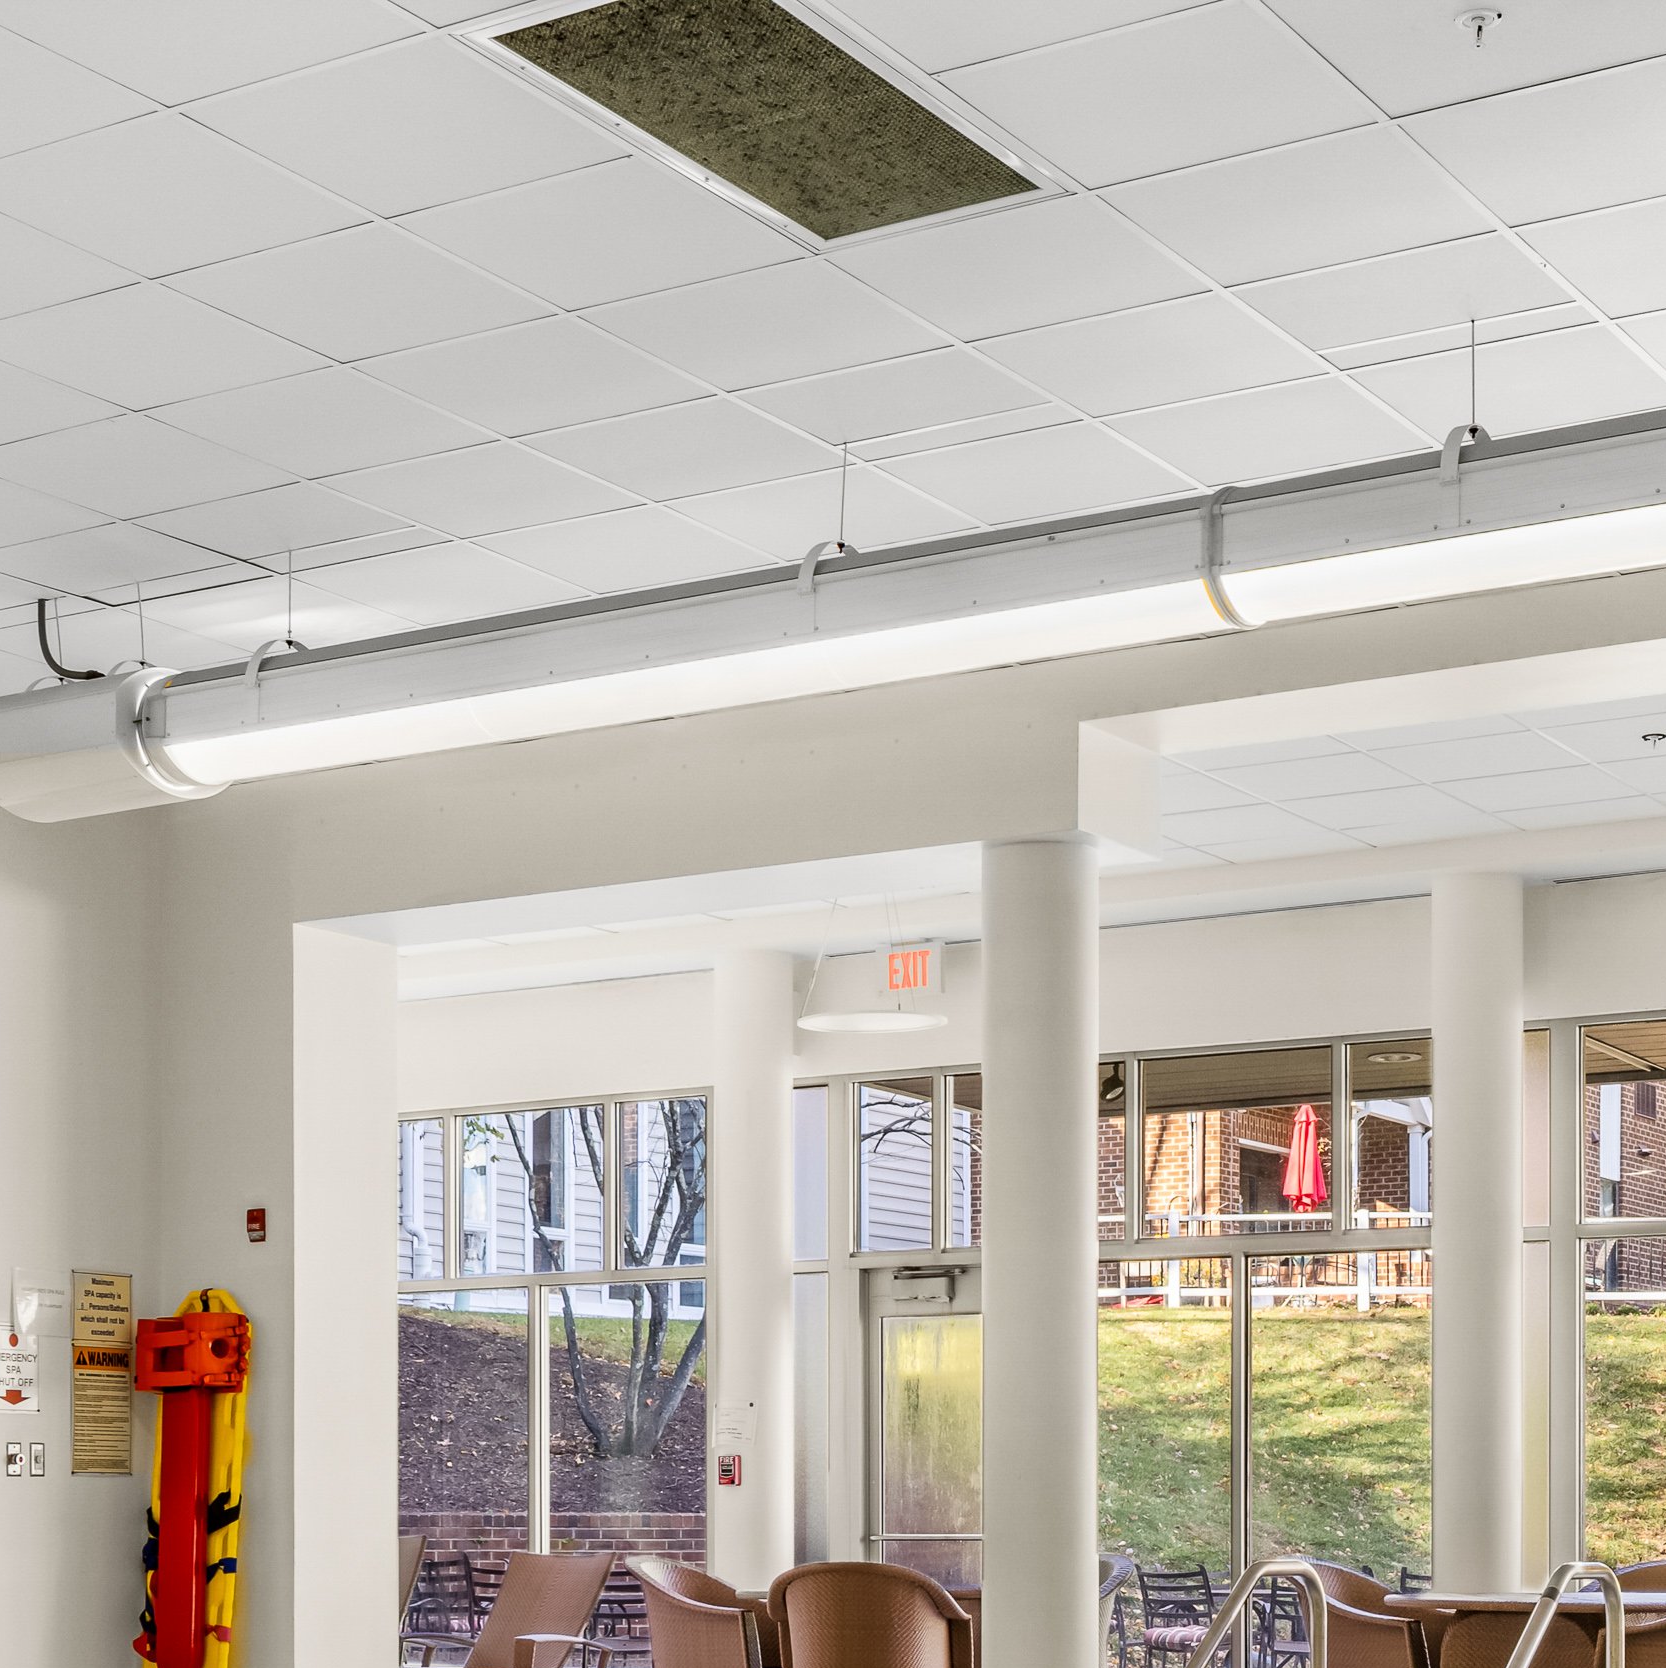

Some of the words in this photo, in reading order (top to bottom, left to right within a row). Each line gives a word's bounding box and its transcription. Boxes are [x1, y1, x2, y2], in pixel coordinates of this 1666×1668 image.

[888, 950, 931, 990] EXIT
[91, 1277, 114, 1286] Maximum
[84, 1289, 95, 1297] SPA
[95, 1292, 115, 1300] capacity
[116, 1292, 122, 1300] is
[89, 1302, 129, 1312] Persons/Bathers
[96, 1316, 108, 1324] shall
[119, 1317, 125, 1325] be
[91, 1329, 115, 1337] exceeded
[88, 1351, 129, 1368] WARNING
[6, 1365, 22, 1374] SPA
[17, 1378, 34, 1387] OFF
